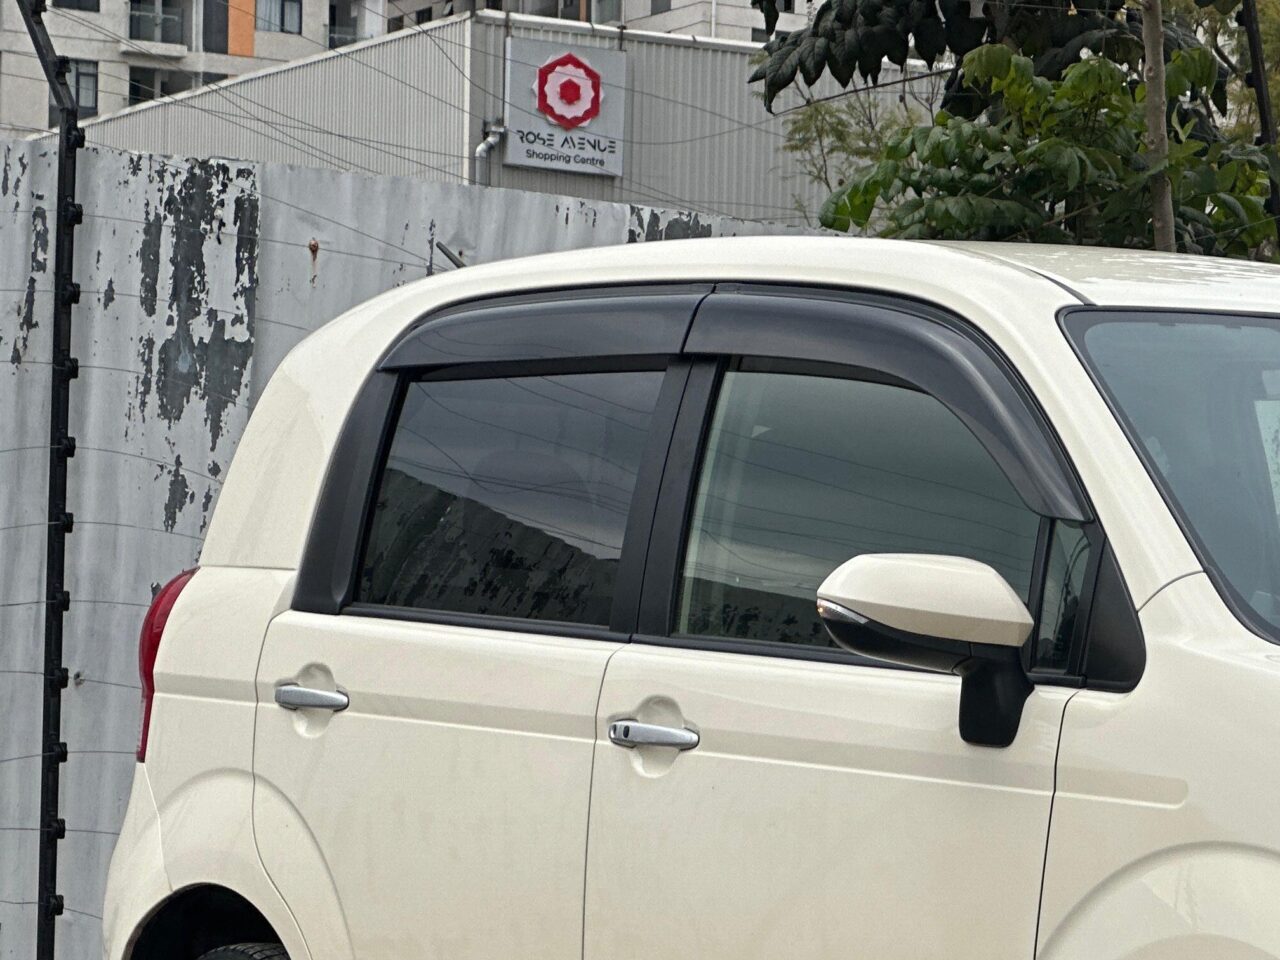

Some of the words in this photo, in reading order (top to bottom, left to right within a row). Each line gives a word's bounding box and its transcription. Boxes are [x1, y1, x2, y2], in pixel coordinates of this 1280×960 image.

[516, 130, 554, 147] ROSE
[526, 149, 571, 165] Shopping
[573, 154, 605, 167] Centre
